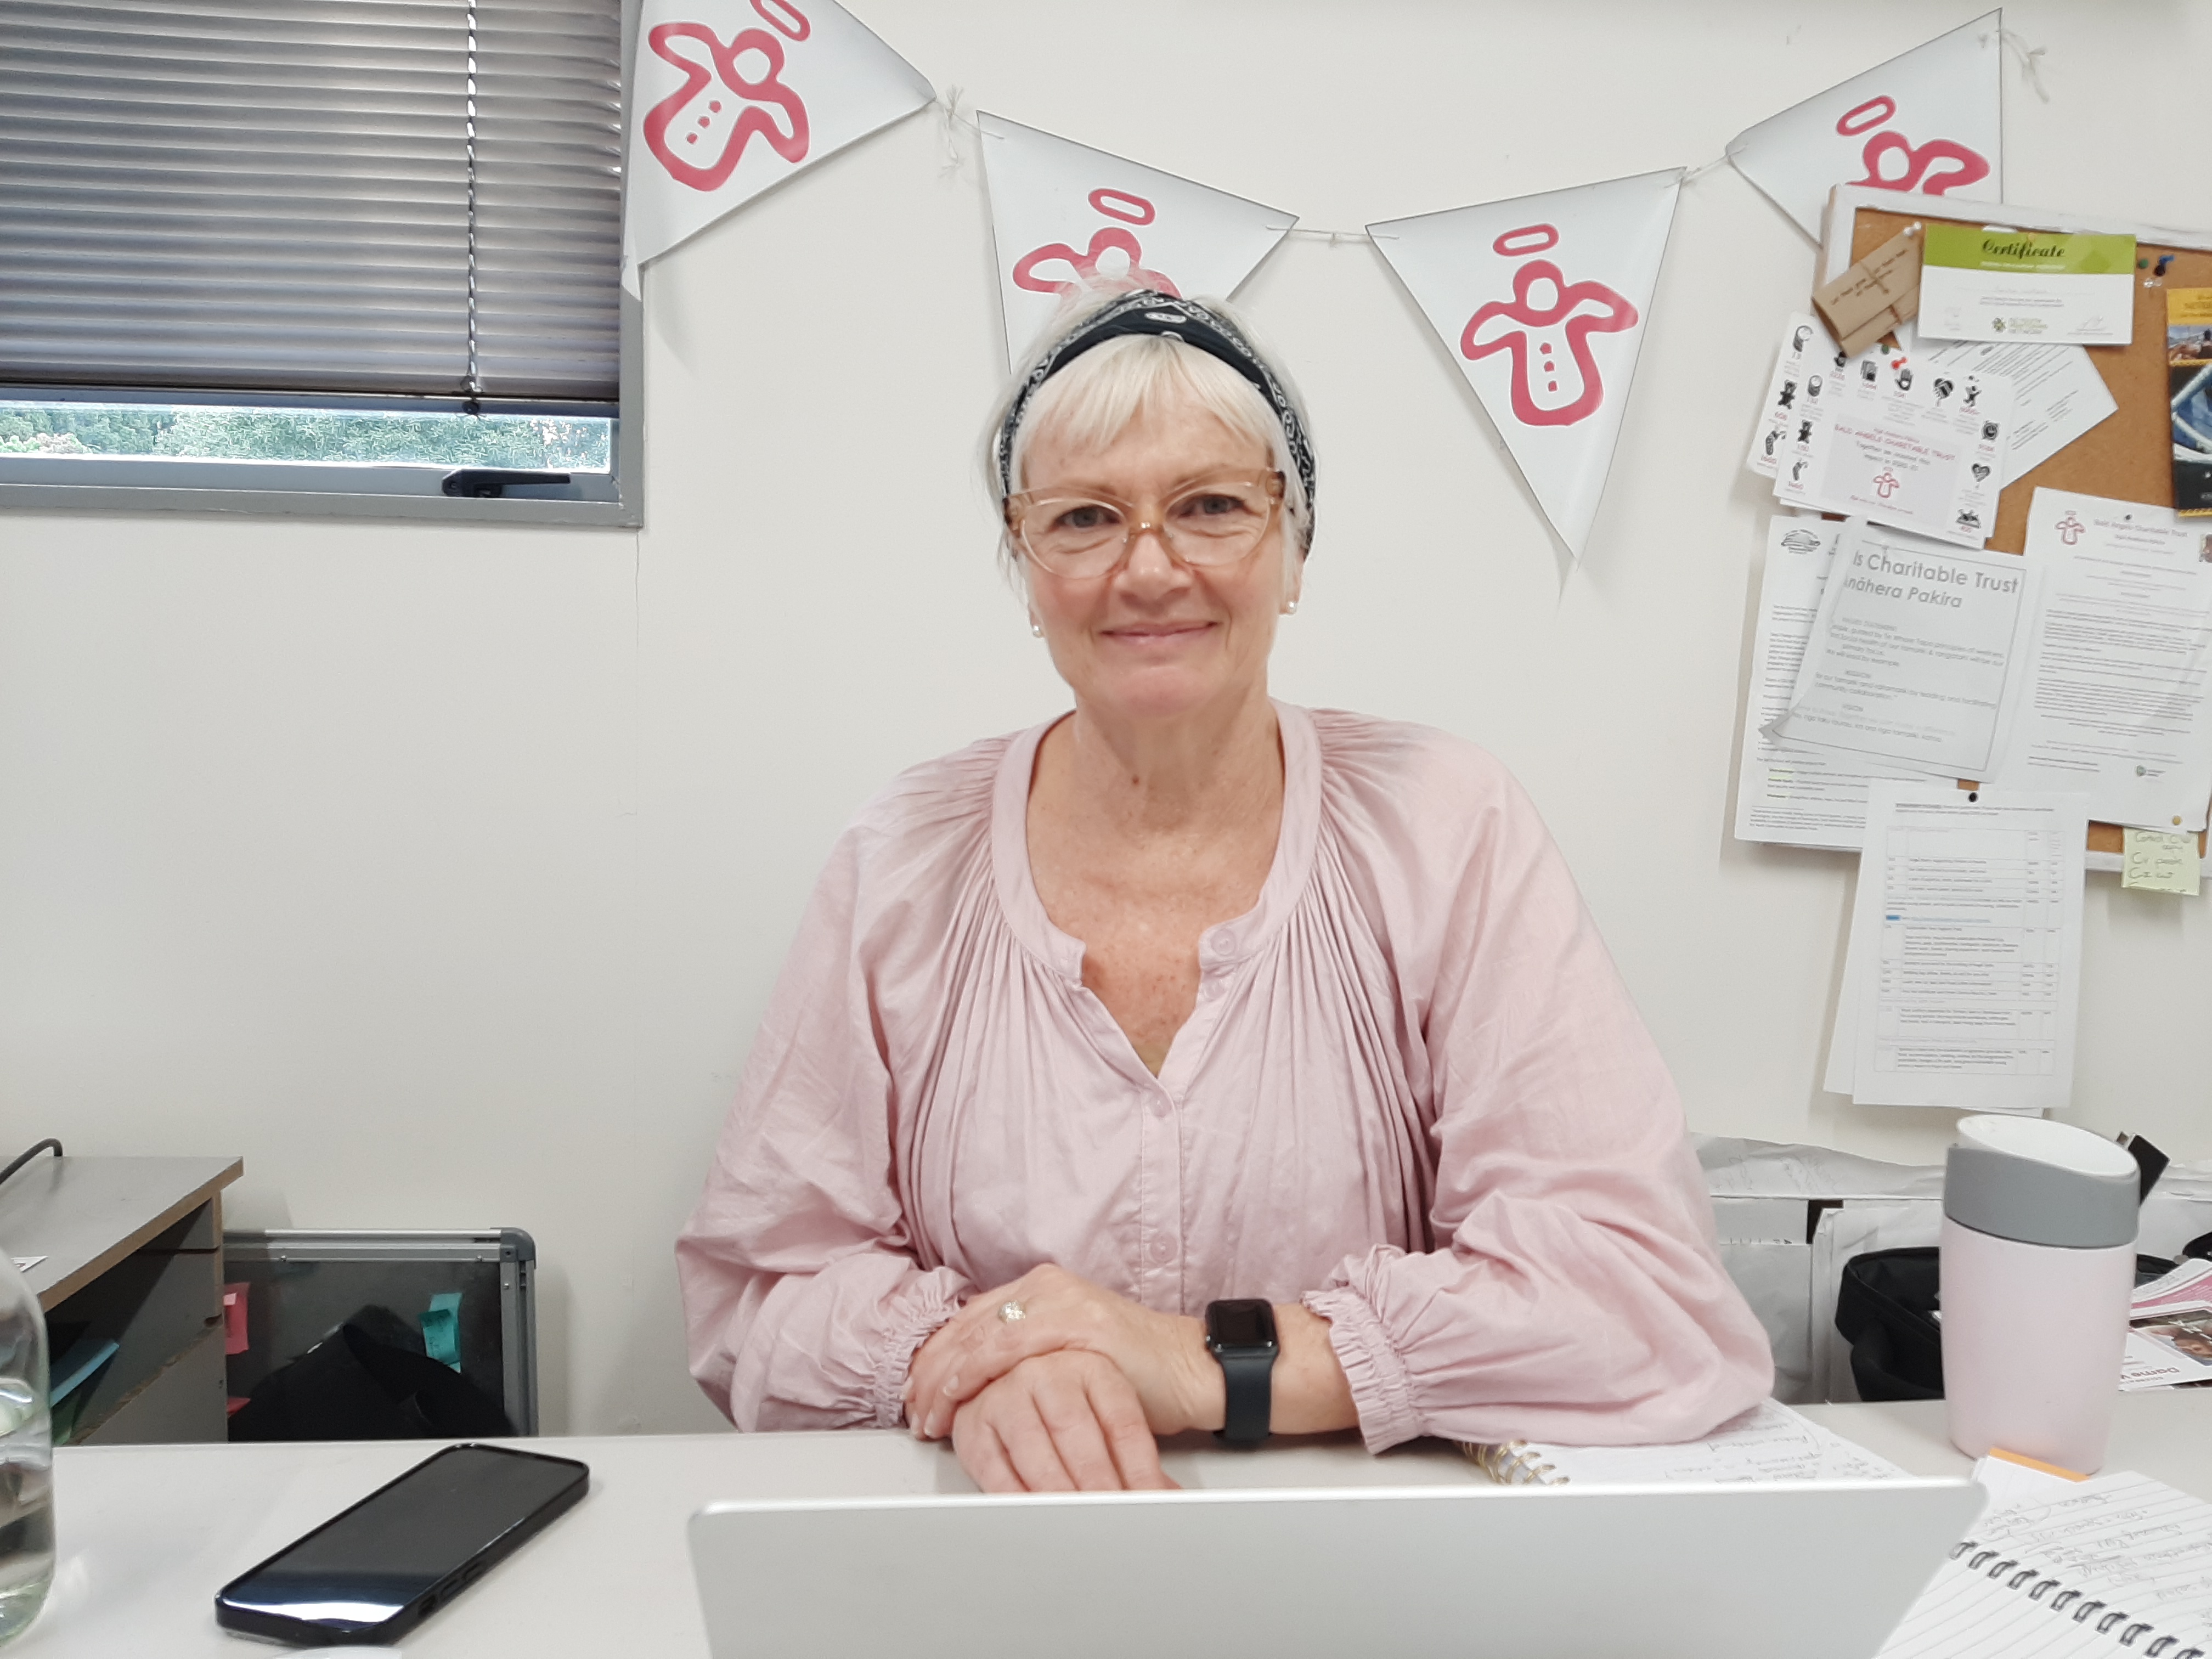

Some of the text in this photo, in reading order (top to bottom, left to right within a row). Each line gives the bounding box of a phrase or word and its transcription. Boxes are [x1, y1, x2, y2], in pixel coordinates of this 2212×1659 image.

[1983, 239, 2066, 259] Certificate
[1868, 554, 1968, 585] Charitable
[1976, 571, 2019, 594] Trust
[1907, 586, 1963, 608] Pakira
